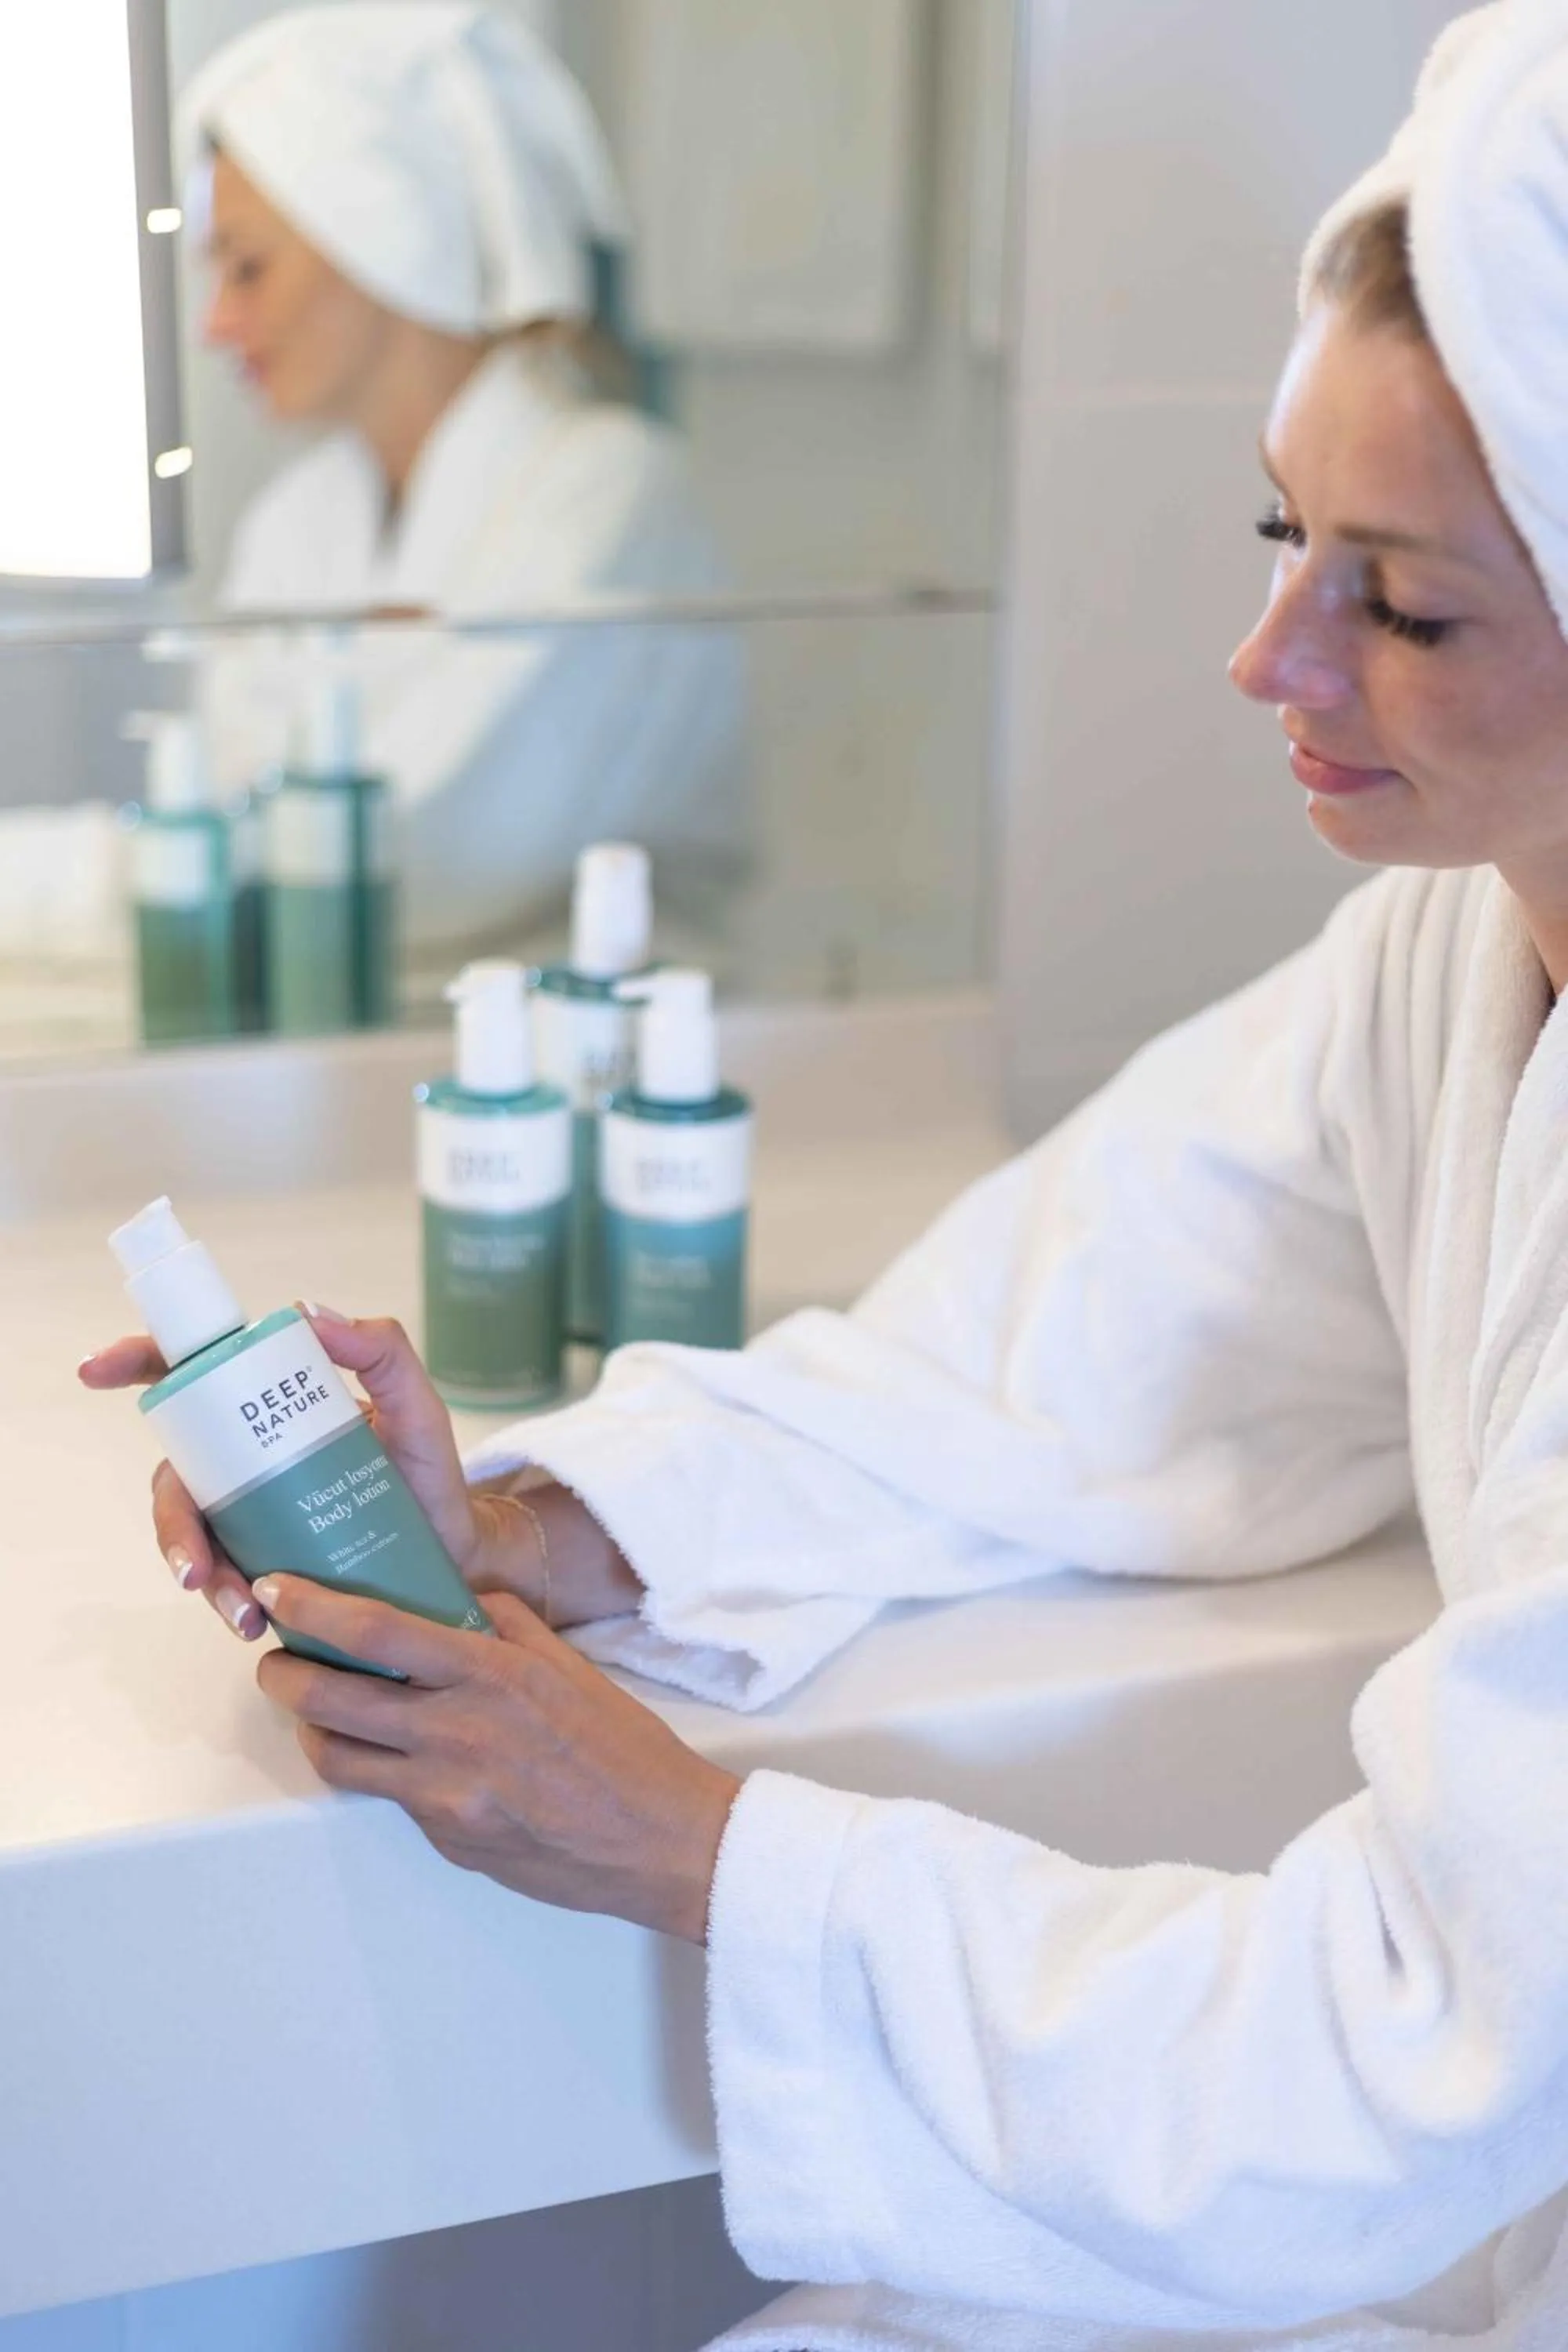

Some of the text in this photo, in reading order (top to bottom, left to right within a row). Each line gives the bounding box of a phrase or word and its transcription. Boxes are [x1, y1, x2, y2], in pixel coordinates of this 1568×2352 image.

[239, 1370, 308, 1422] DEEP
[252, 1385, 329, 1438] NATURE
[261, 1432, 283, 1448] SPA
[296, 1479, 347, 1512] Vücut
[307, 1479, 390, 1534] Body lotion
